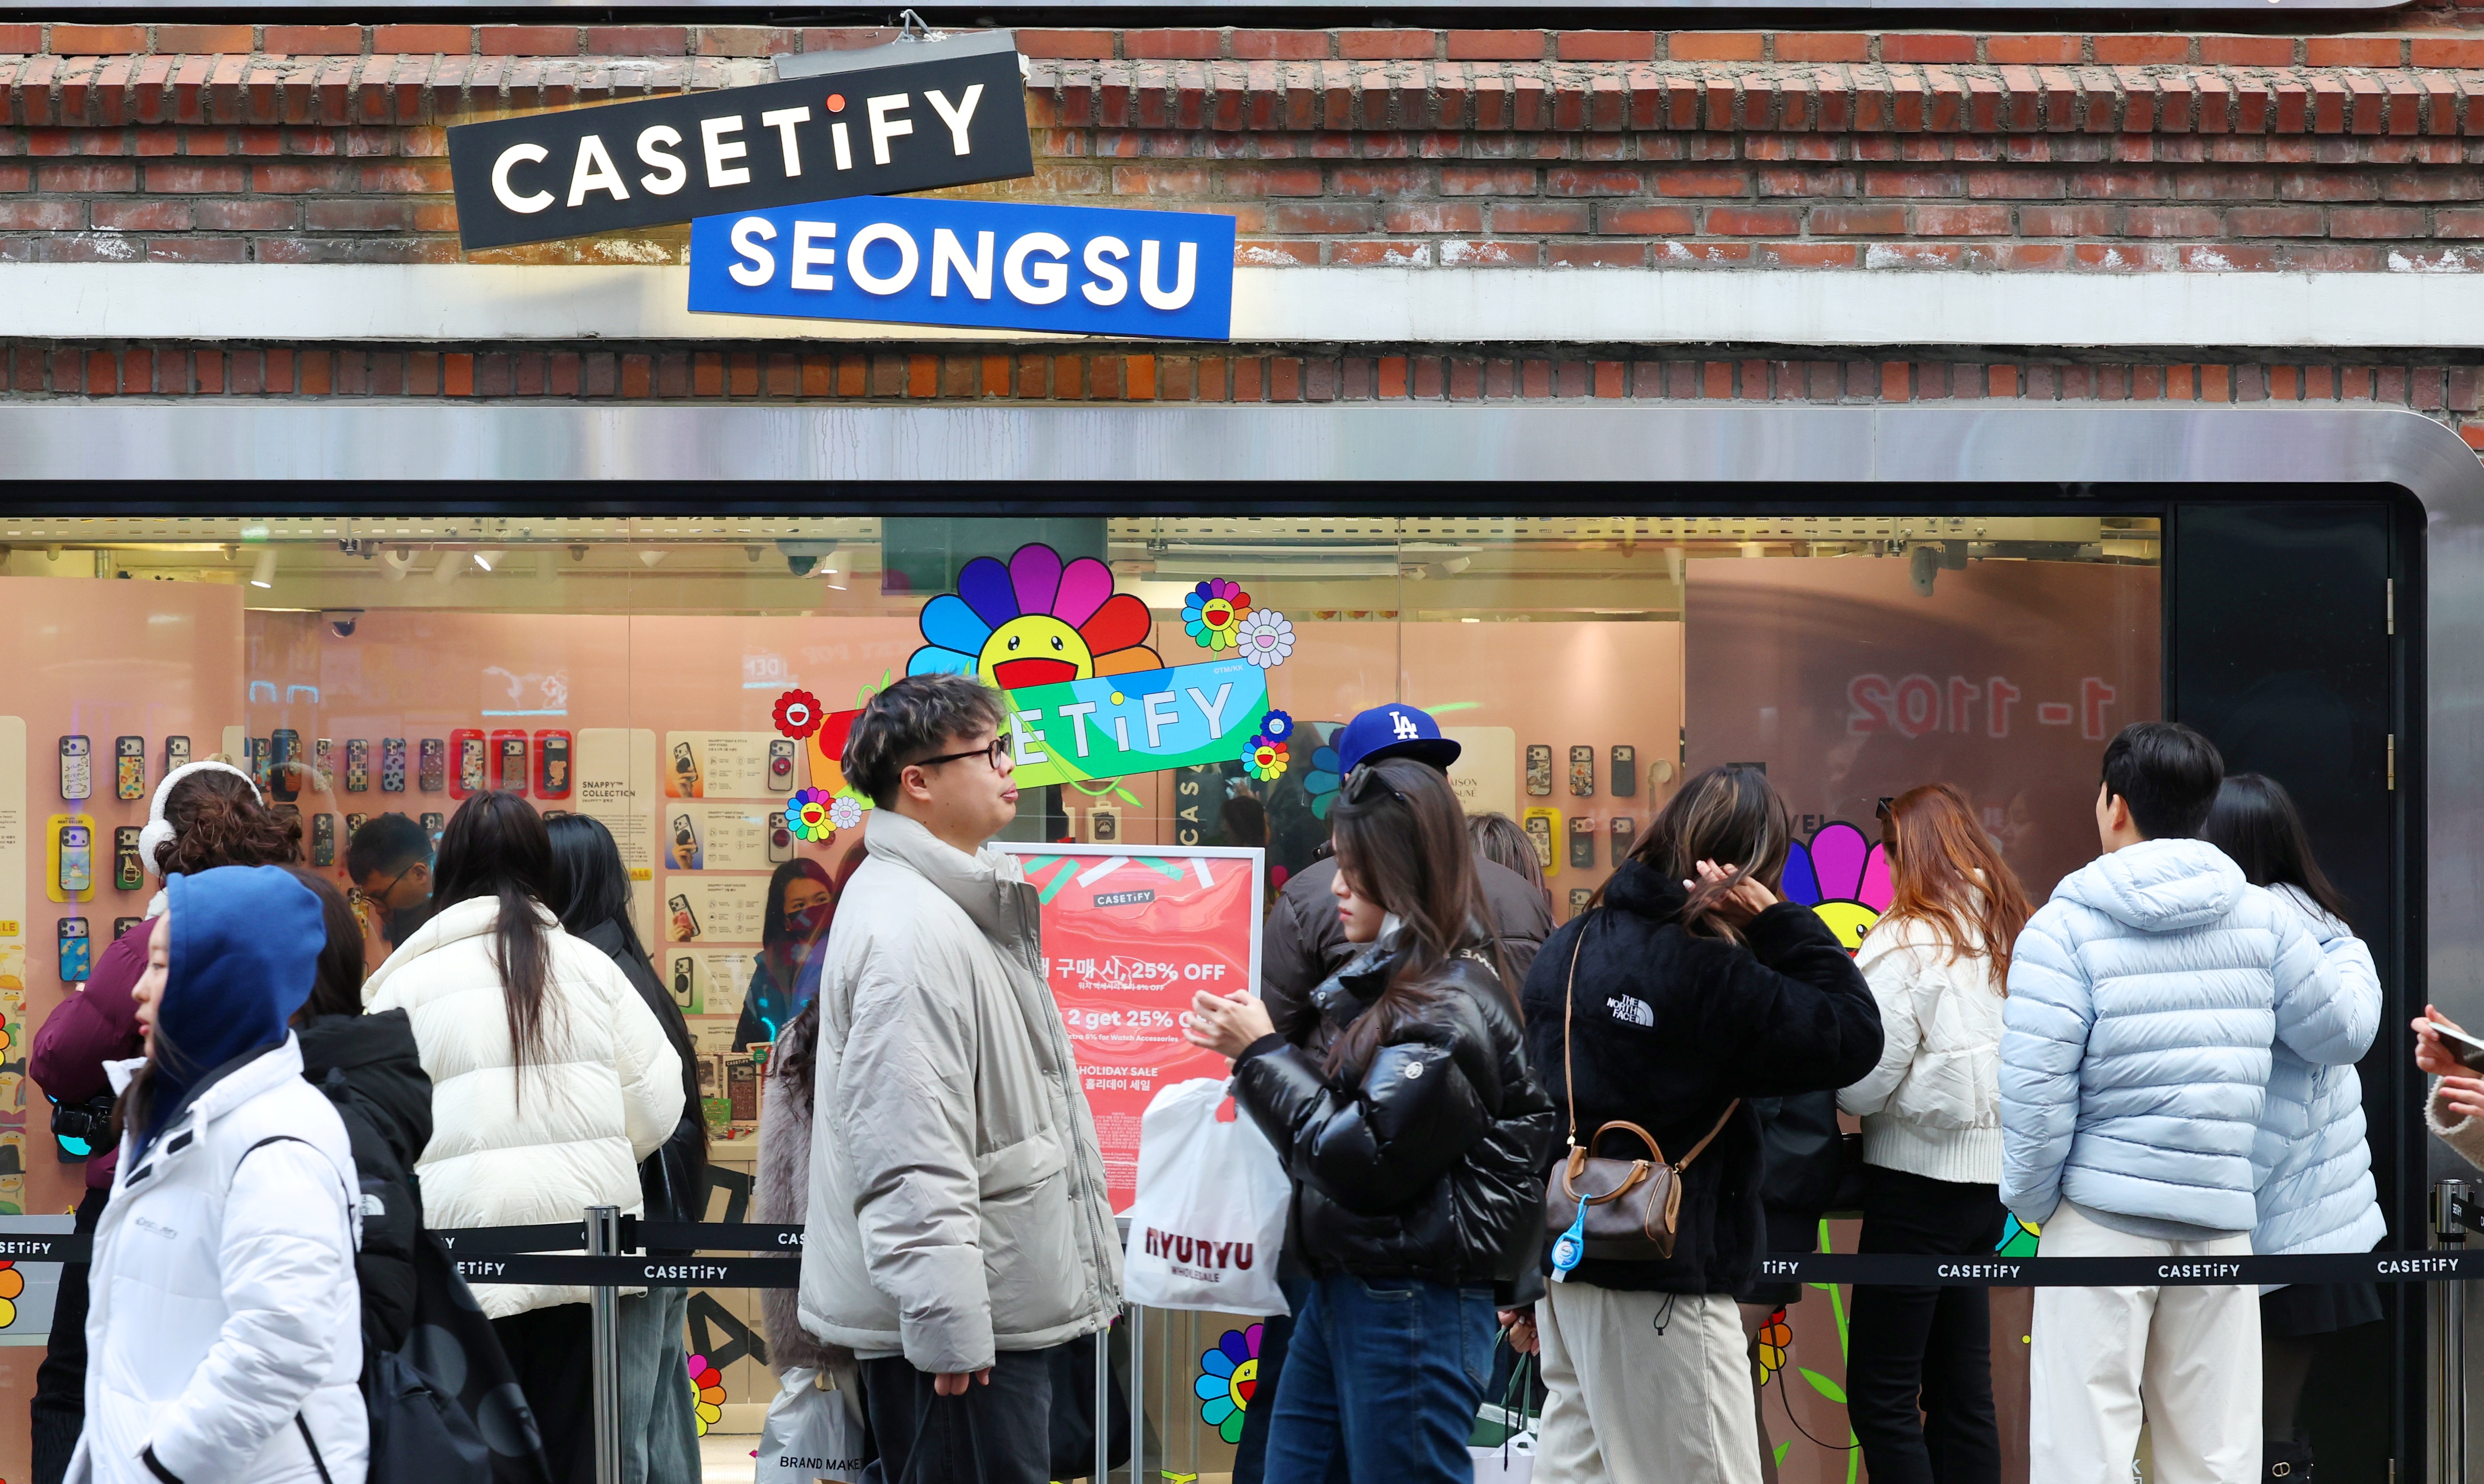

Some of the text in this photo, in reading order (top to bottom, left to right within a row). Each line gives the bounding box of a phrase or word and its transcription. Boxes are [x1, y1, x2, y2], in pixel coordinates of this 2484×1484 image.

[491, 83, 985, 215] CASETiFY
[728, 216, 1199, 311] SEONGSU
[1009, 682, 1234, 766] ETiFY
[1389, 711, 1419, 740] LA
[1456, 788, 1476, 797] SUNÉ
[630, 870, 649, 878] ALE
[1097, 892, 1150, 905] CASETiFY
[1056, 958, 1095, 979] 구매
[1132, 962, 1178, 980] 25%
[1184, 964, 1226, 980] OFF
[1607, 997, 1637, 1015] NORTH
[1621, 994, 1639, 1007] THE
[1068, 1009, 1080, 1025] 2
[1085, 1011, 1121, 1030] get
[1126, 1010, 1173, 1027] 25%
[1613, 1008, 1636, 1022] FACE
[1079, 1066, 1158, 1077] HOLIDAY SALE
[1085, 1078, 1150, 1091] 홀리데이 세일
[0, 1241, 51, 1254] SETiFY
[457, 1261, 505, 1276] ETiFY
[644, 1265, 727, 1279] CASETiFY
[1763, 1260, 1799, 1274] TiFY
[1937, 1264, 2020, 1278] CASETiFY
[2157, 1263, 2240, 1278] CASETiFY
[2377, 1258, 2459, 1274] CASETiFY
[1170, 1266, 1220, 1283] WHOLESALE
[780, 1456, 823, 1469] BRAND
